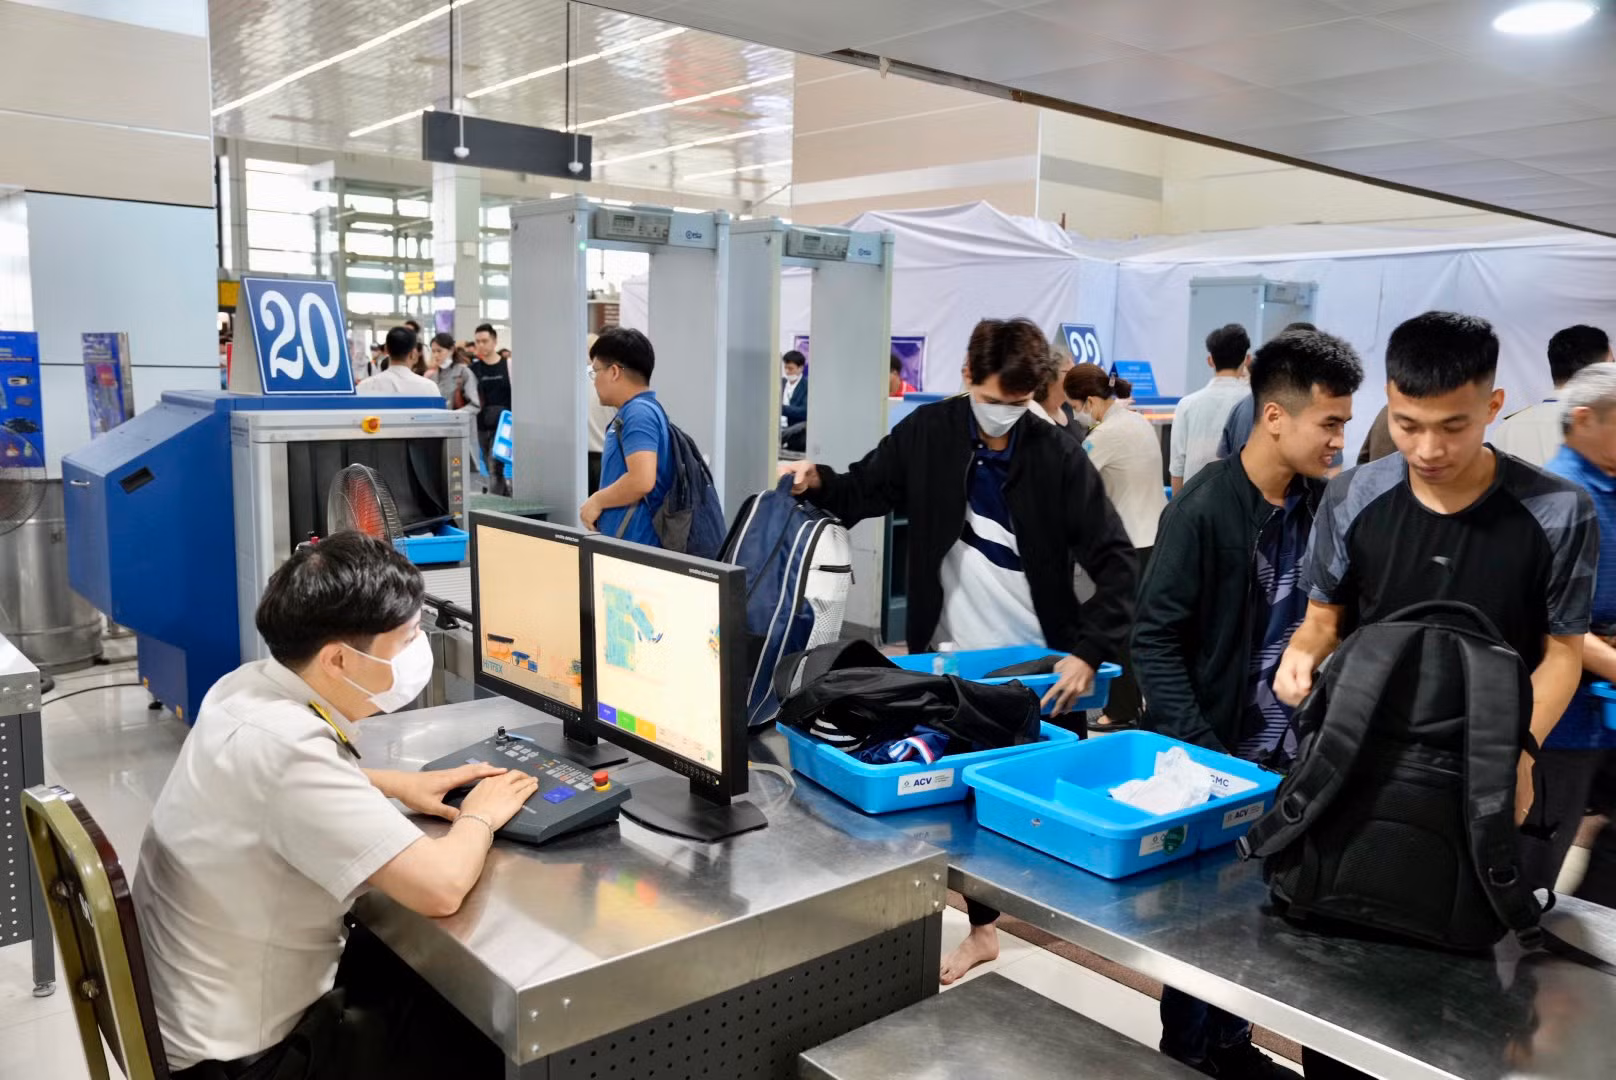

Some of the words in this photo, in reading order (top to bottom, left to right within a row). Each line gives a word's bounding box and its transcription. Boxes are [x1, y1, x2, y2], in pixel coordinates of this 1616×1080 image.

[260, 290, 340, 380] 20
[914, 777, 932, 786] ACV
[1235, 808, 1248, 818] ACV
